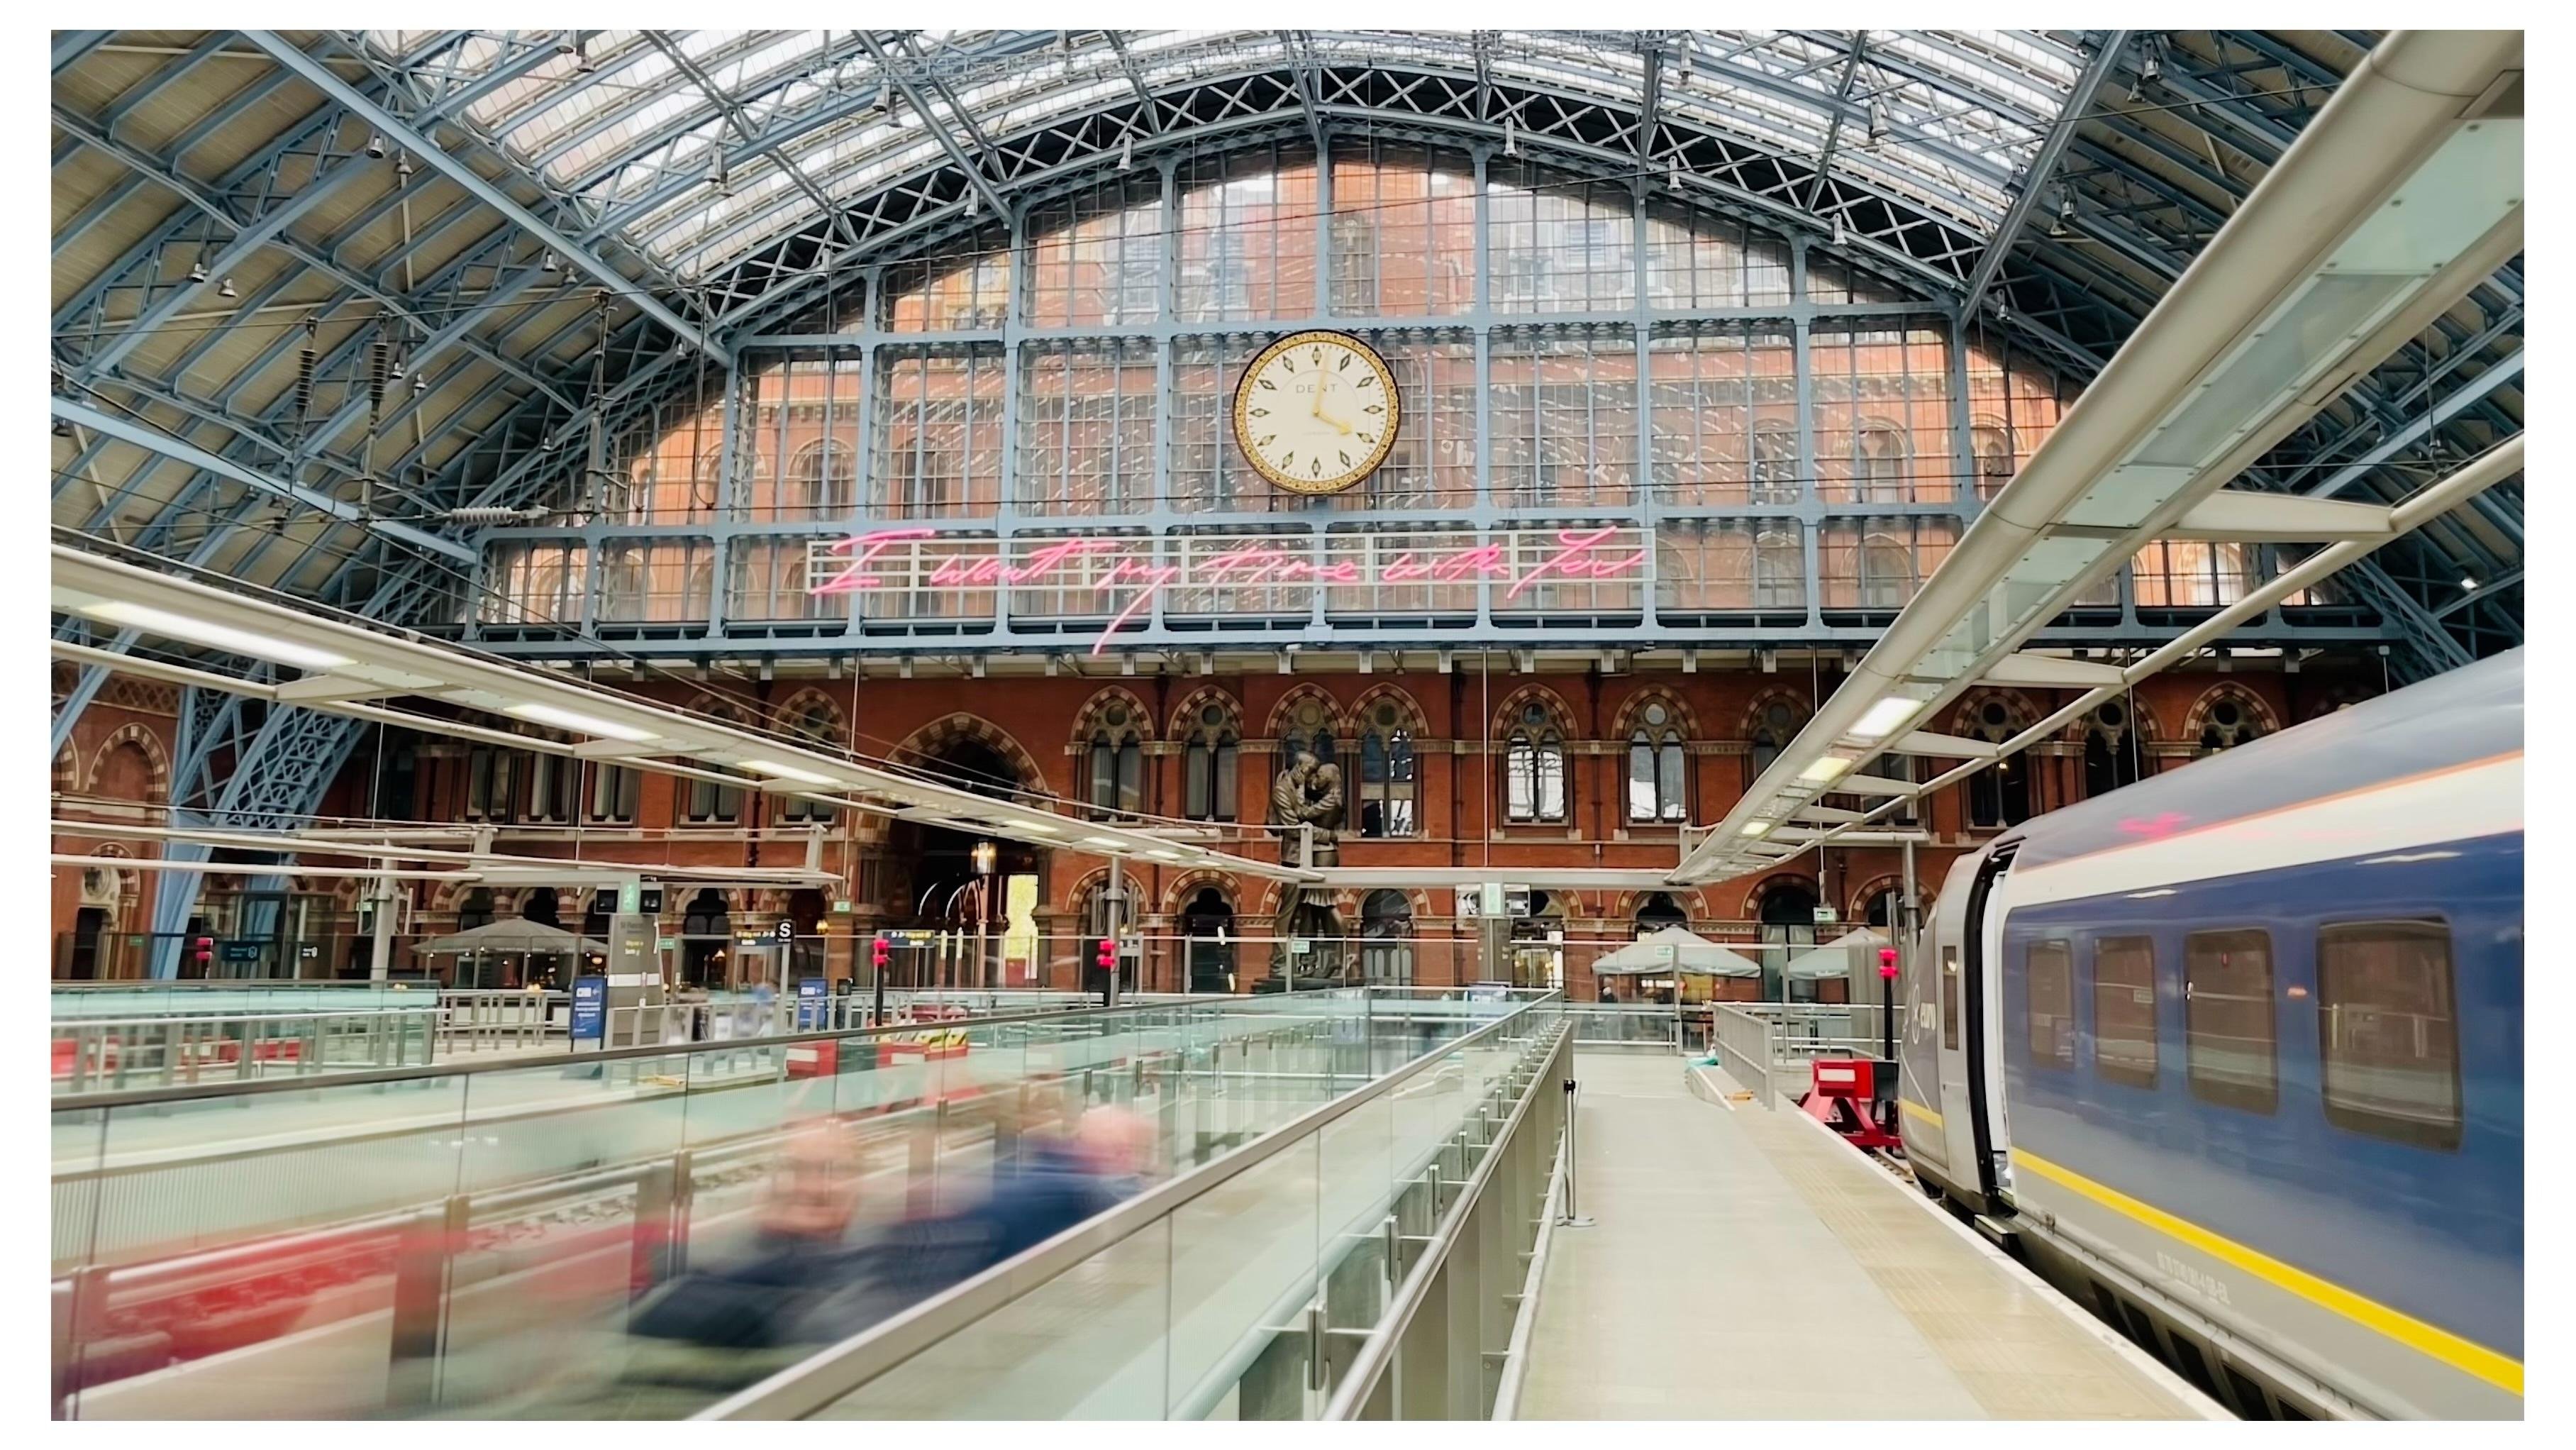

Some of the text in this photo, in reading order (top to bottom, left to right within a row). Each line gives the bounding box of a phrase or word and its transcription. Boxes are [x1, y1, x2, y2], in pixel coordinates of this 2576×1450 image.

[1296, 382, 1338, 393] DENT
[810, 528, 935, 594] I
[931, 537, 1116, 587] want
[1093, 556, 1179, 655] my
[1382, 541, 1509, 581] with
[779, 922, 791, 938] S
